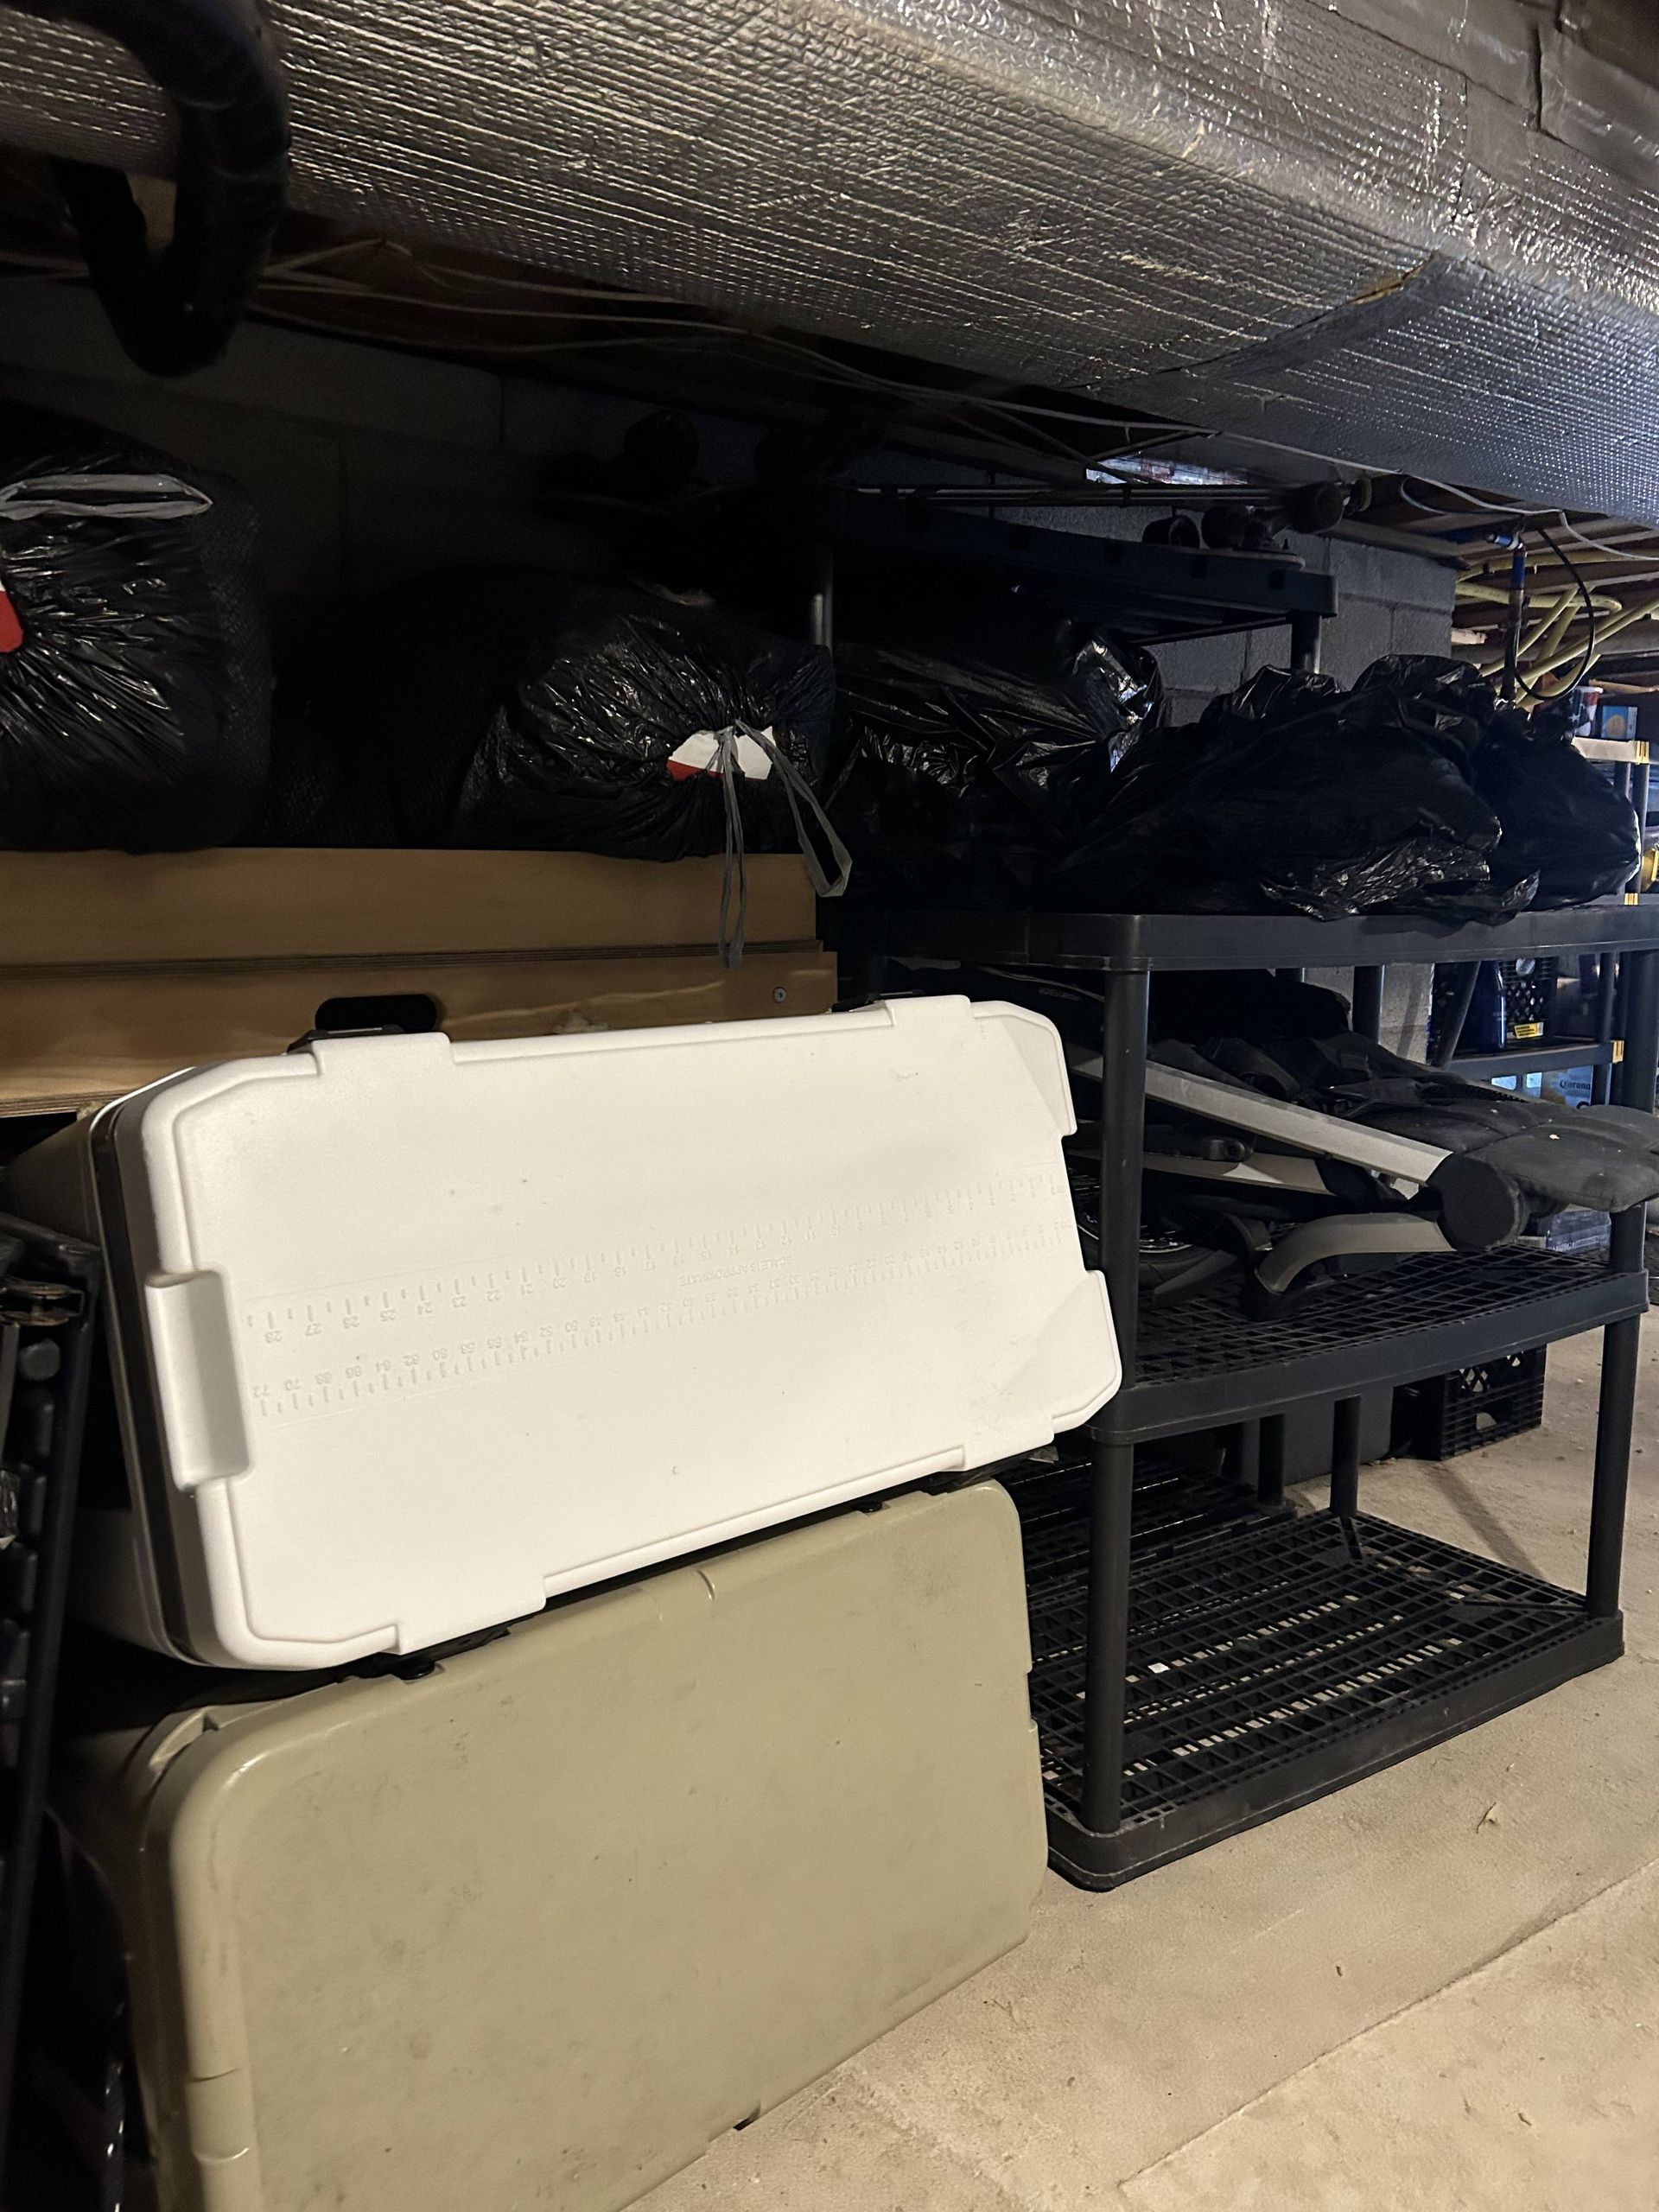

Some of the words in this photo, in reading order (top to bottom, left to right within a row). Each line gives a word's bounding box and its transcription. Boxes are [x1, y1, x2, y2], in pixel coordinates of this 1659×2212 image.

[1560, 1079, 1591, 1090] Corona
[760, 1254, 792, 1271] SCALE
[583, 1272, 596, 1283] 19
[677, 1263, 749, 1287] APPROXIMATE
[520, 1283, 533, 1295] 21
[552, 1277, 567, 1289] 20
[451, 1296, 467, 1308] 23
[486, 1290, 500, 1302] 22
[416, 1302, 432, 1315] 24
[380, 1309, 397, 1322] 25
[305, 1323, 321, 1337] 27
